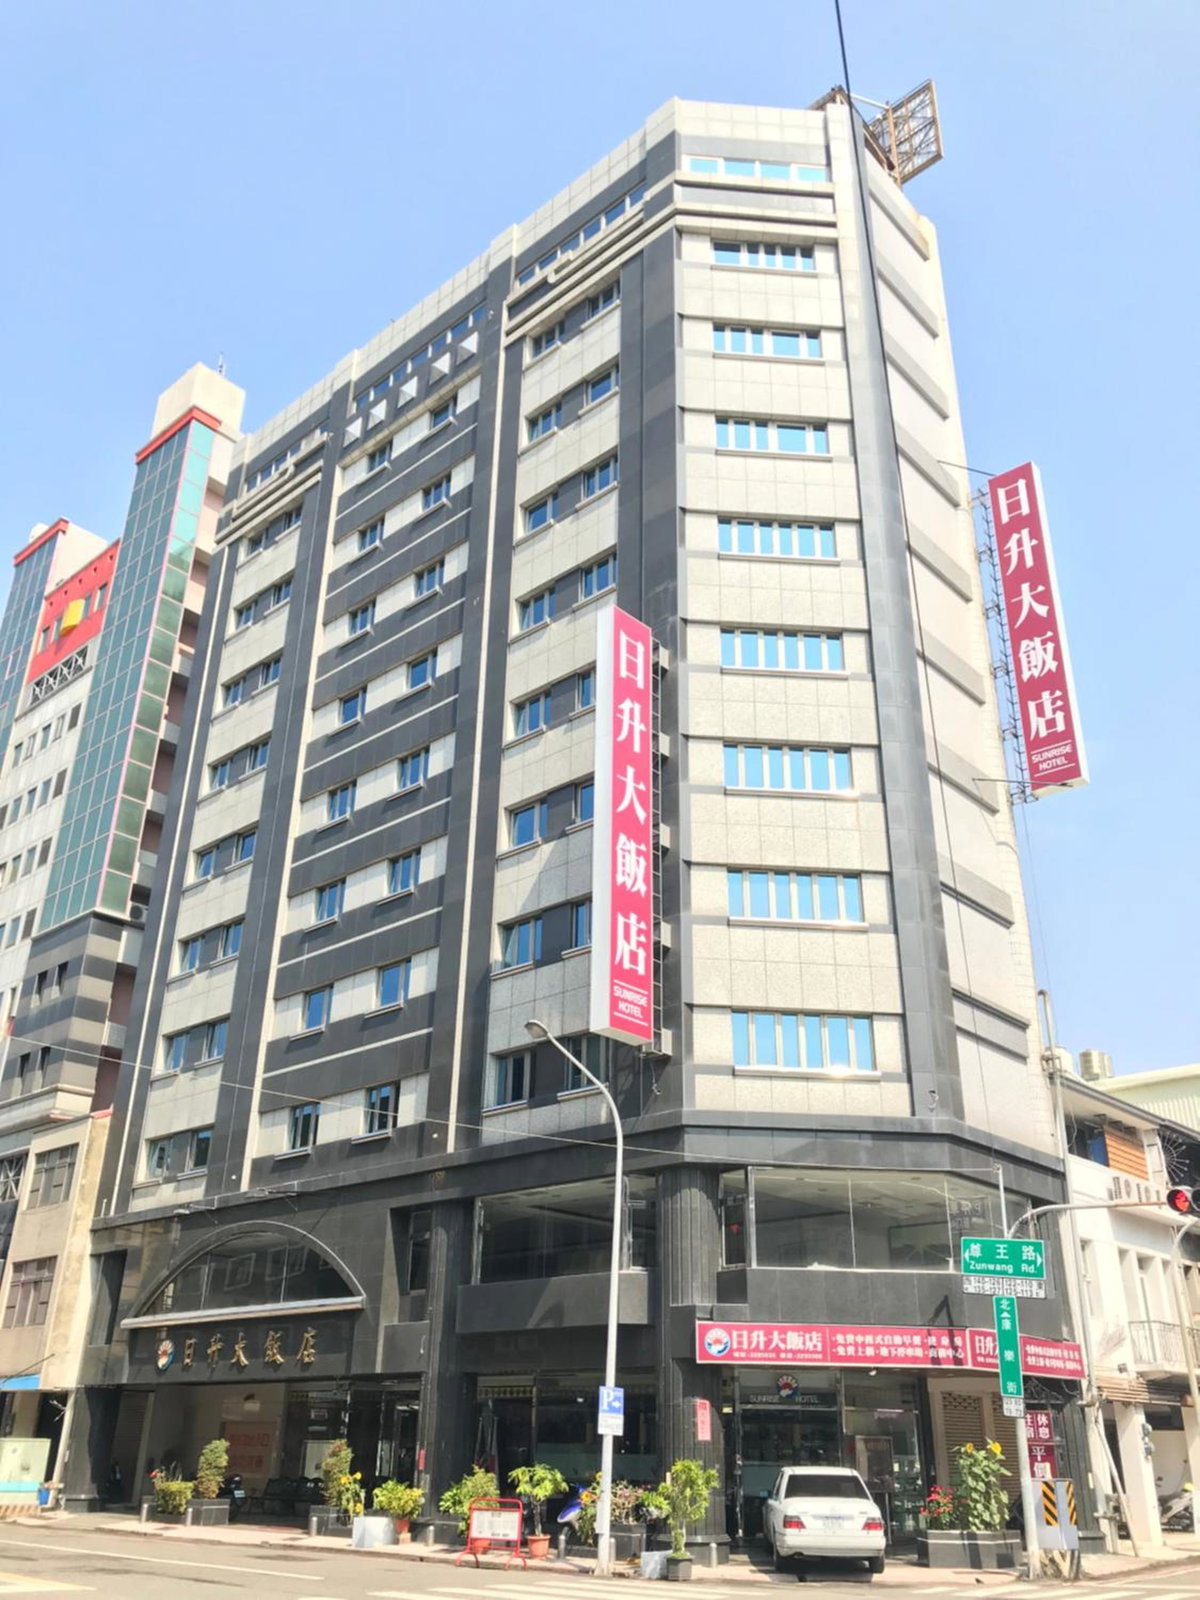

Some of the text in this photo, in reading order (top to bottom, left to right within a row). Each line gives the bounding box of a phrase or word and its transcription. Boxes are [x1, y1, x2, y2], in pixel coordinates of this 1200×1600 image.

[996, 478, 1067, 742] 日升大飯店
[1031, 743, 1072, 764] SUNRISE
[1039, 755, 1068, 771] HOTEL
[614, 629, 648, 976] 日升大飯店
[613, 985, 648, 1008] SUNRISE
[617, 1001, 643, 1018] HOTEL
[969, 1242, 1036, 1261] 尊王路
[969, 1260, 1038, 1274] Zunwang Rd.
[1000, 1299, 1011, 1311] 北
[184, 1326, 318, 1367] 日升大飯店
[731, 1330, 823, 1352] 日升大飯店
[1001, 1318, 1017, 1394] 康樂街
[602, 1390, 614, 1410] P
[795, 1394, 819, 1404] HOTEL
